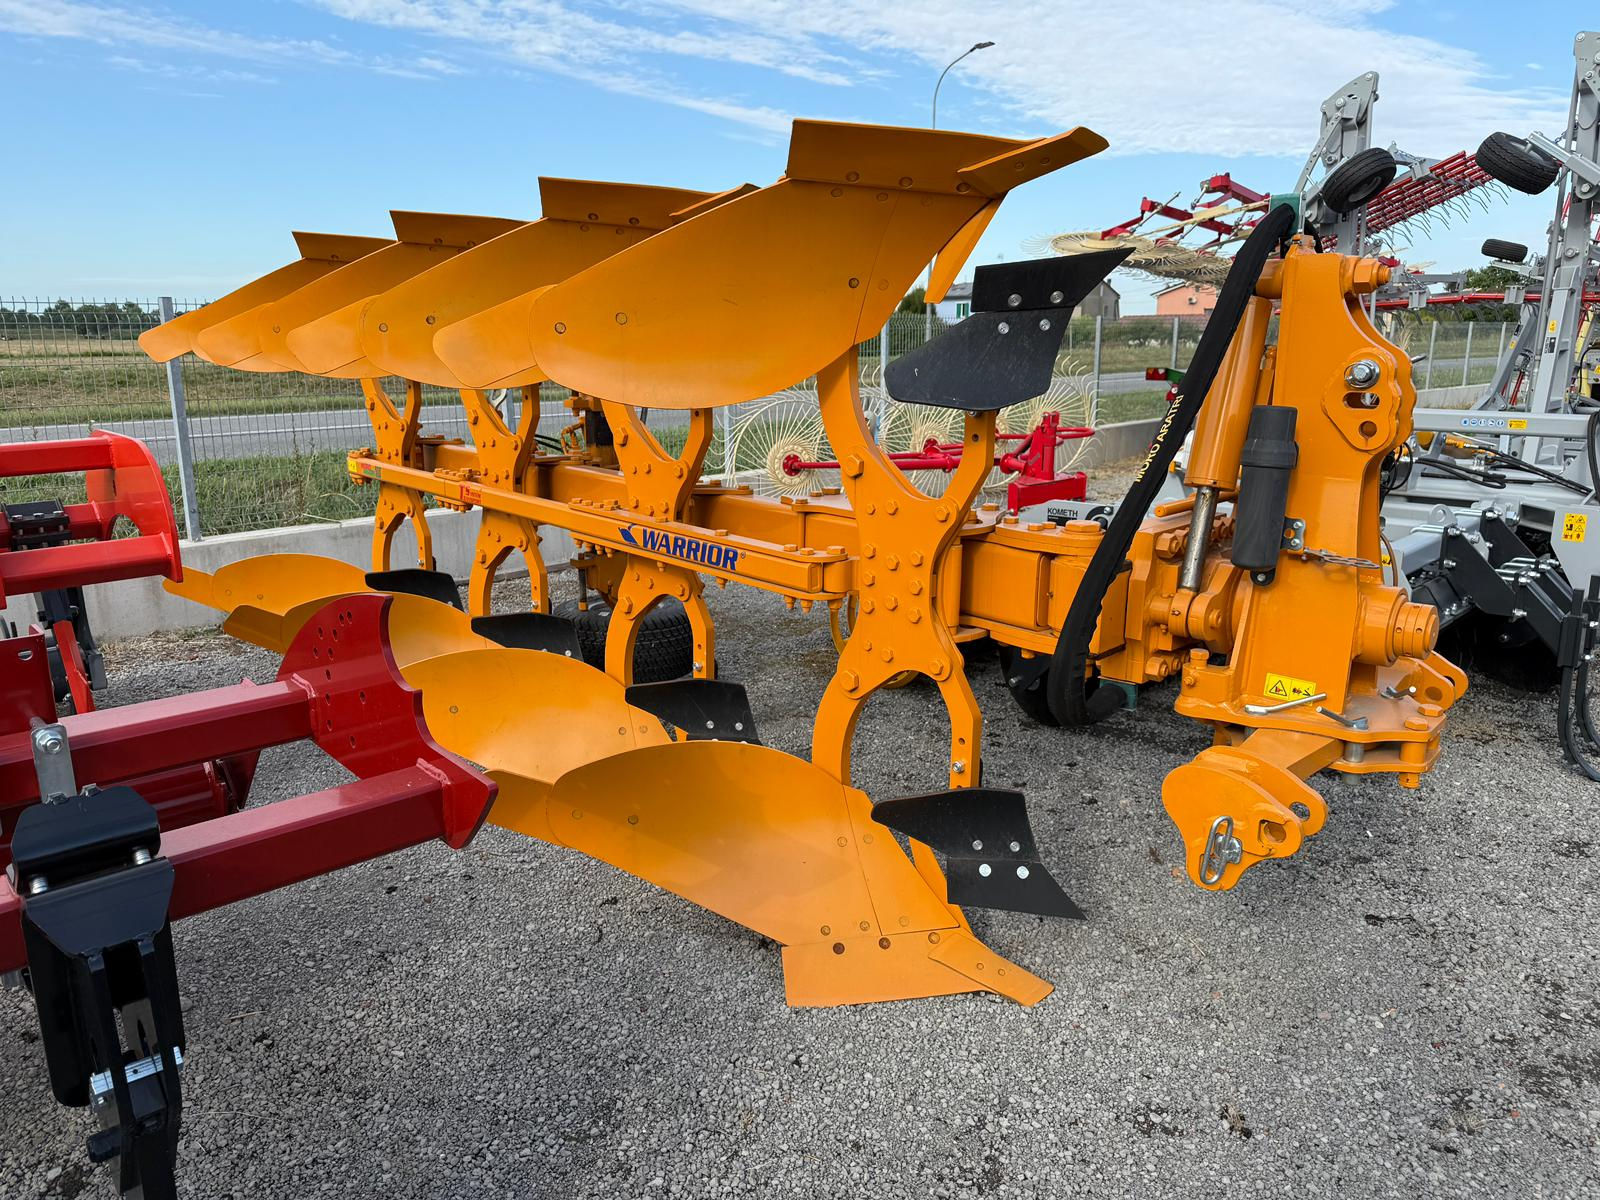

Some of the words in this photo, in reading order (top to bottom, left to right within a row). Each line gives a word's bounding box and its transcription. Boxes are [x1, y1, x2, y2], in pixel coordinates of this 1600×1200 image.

[1157, 395, 1184, 441] ARATRI
[1047, 507, 1078, 517] KOMETH
[643, 528, 738, 570] WARRIOR
